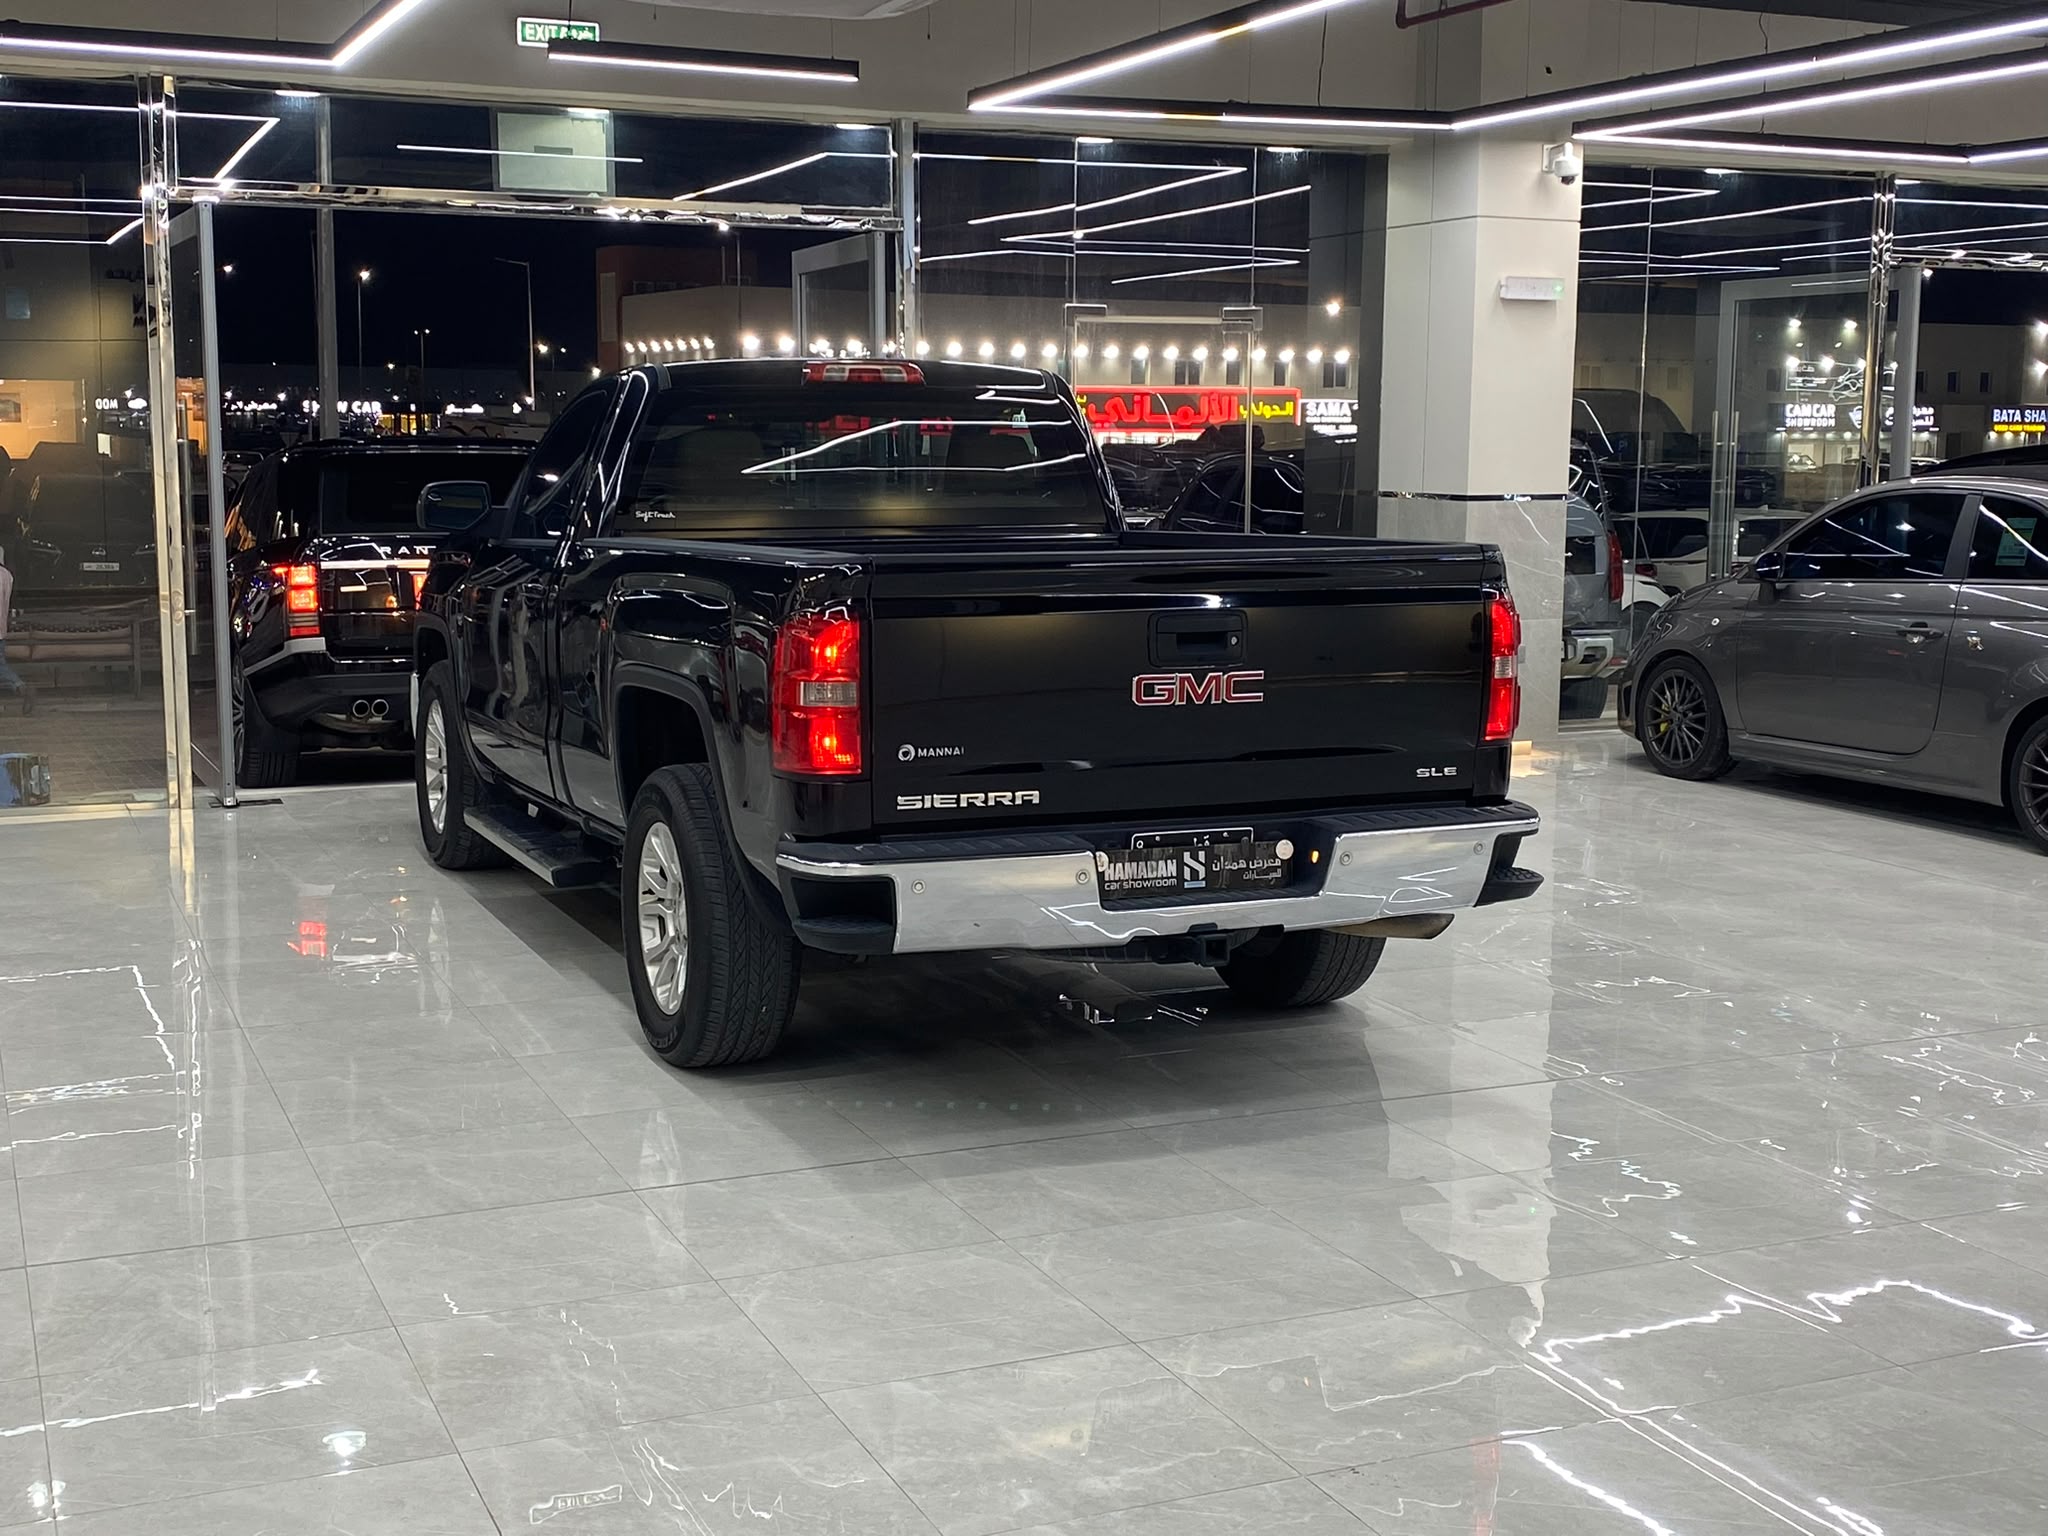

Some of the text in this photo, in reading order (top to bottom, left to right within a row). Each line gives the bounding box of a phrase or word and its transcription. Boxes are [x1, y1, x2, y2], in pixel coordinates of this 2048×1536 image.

[525, 23, 558, 41] EXIT
[351, 400, 382, 413] CAR
[1305, 401, 1352, 416] SAMA
[1993, 408, 2022, 422] BATA
[1785, 418, 1836, 427] SHOWROOM
[1132, 670, 1264, 706] GMC
[917, 746, 965, 758] MANNAI
[1416, 766, 1457, 778] SLE
[897, 790, 1040, 811] SIERRA
[1104, 859, 1177, 881] HAMADAN
[1212, 855, 1247, 871] همدان
[1122, 878, 1177, 889] showroom
